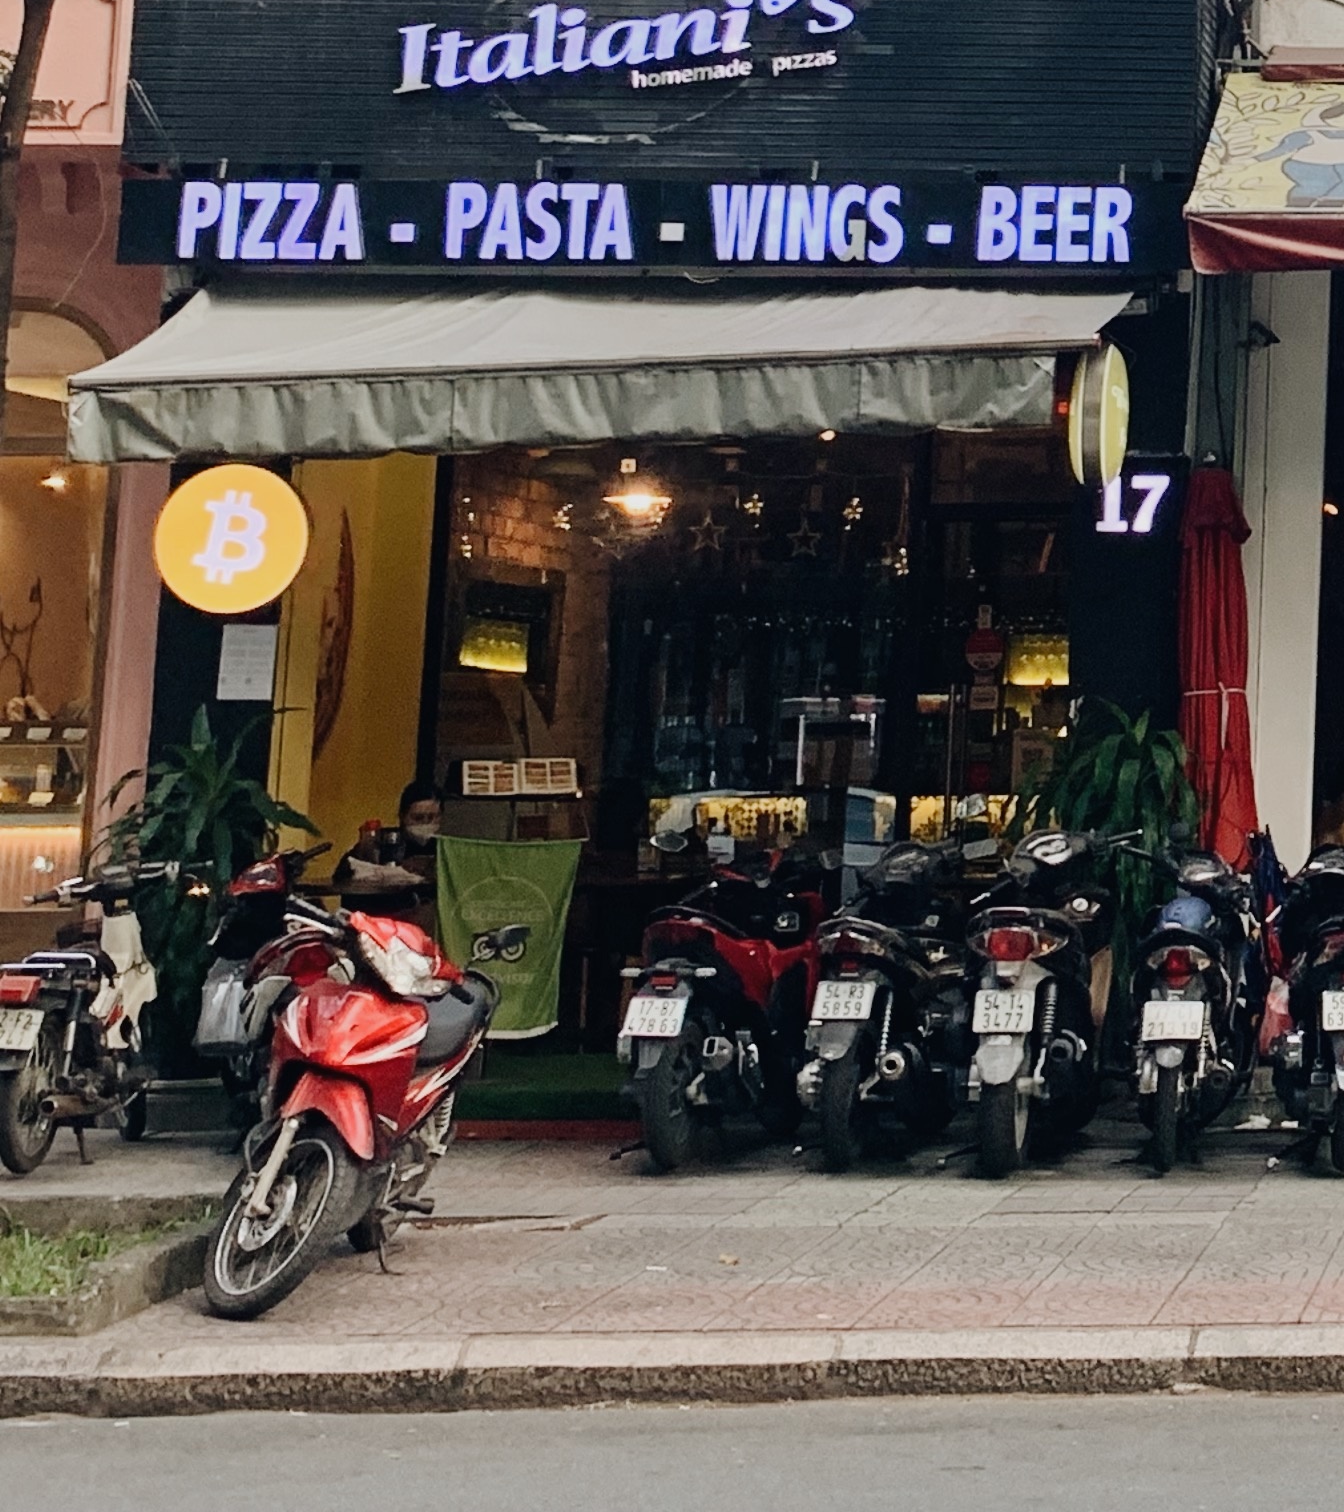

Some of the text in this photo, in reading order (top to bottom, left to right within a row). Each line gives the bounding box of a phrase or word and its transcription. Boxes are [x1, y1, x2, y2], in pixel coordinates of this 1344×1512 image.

[631, 49, 837, 88] homemade pizzas
[178, 181, 365, 261] PIZZA
[444, 181, 634, 262] PASTA
[710, 183, 905, 263] WINGS
[976, 185, 1133, 263] BEER
[1095, 474, 1170, 533] 17
